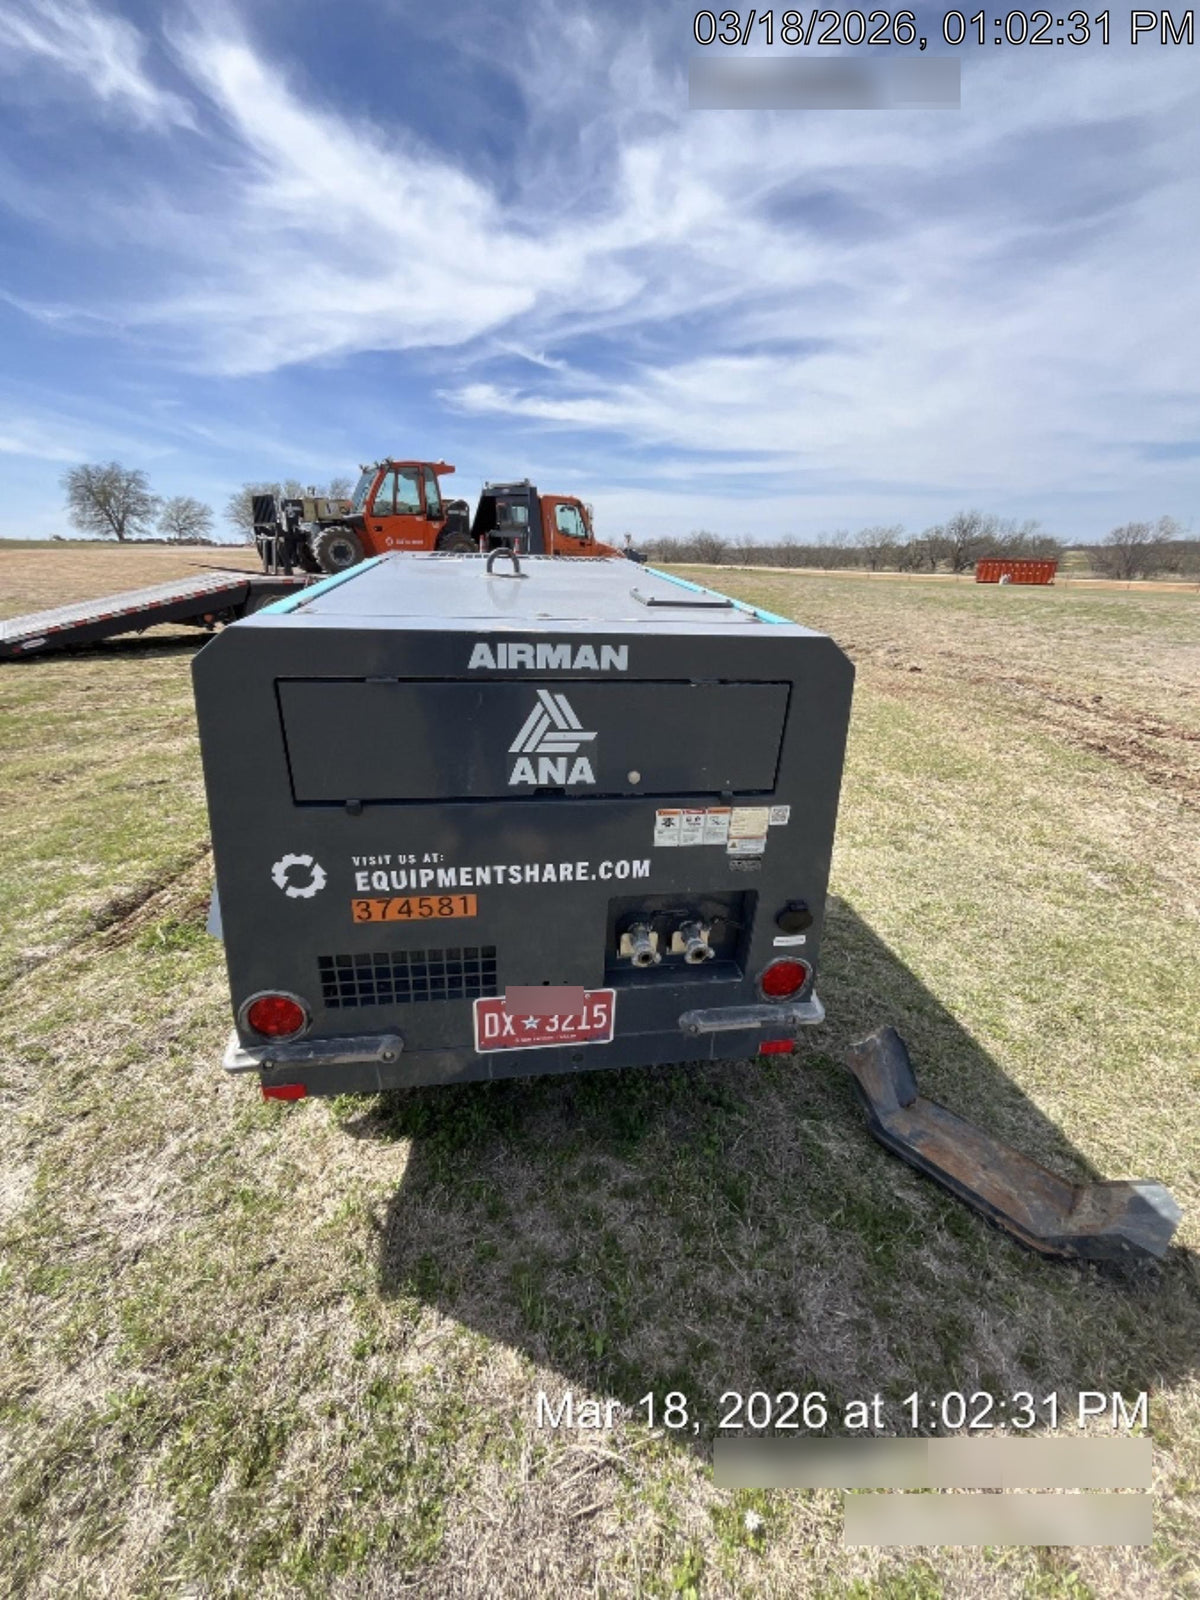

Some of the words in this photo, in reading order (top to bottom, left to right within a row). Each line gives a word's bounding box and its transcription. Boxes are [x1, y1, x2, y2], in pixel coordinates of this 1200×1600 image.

[467, 642, 628, 671] AIRMAN
[508, 757, 596, 785] ANA
[352, 855, 392, 867] VISIT
[398, 854, 417, 865] US
[423, 852, 444, 863] AT:
[354, 859, 651, 892] EQUIPMENTSHARE.COM
[356, 895, 469, 920] 374581
[484, 1011, 516, 1038] DX
